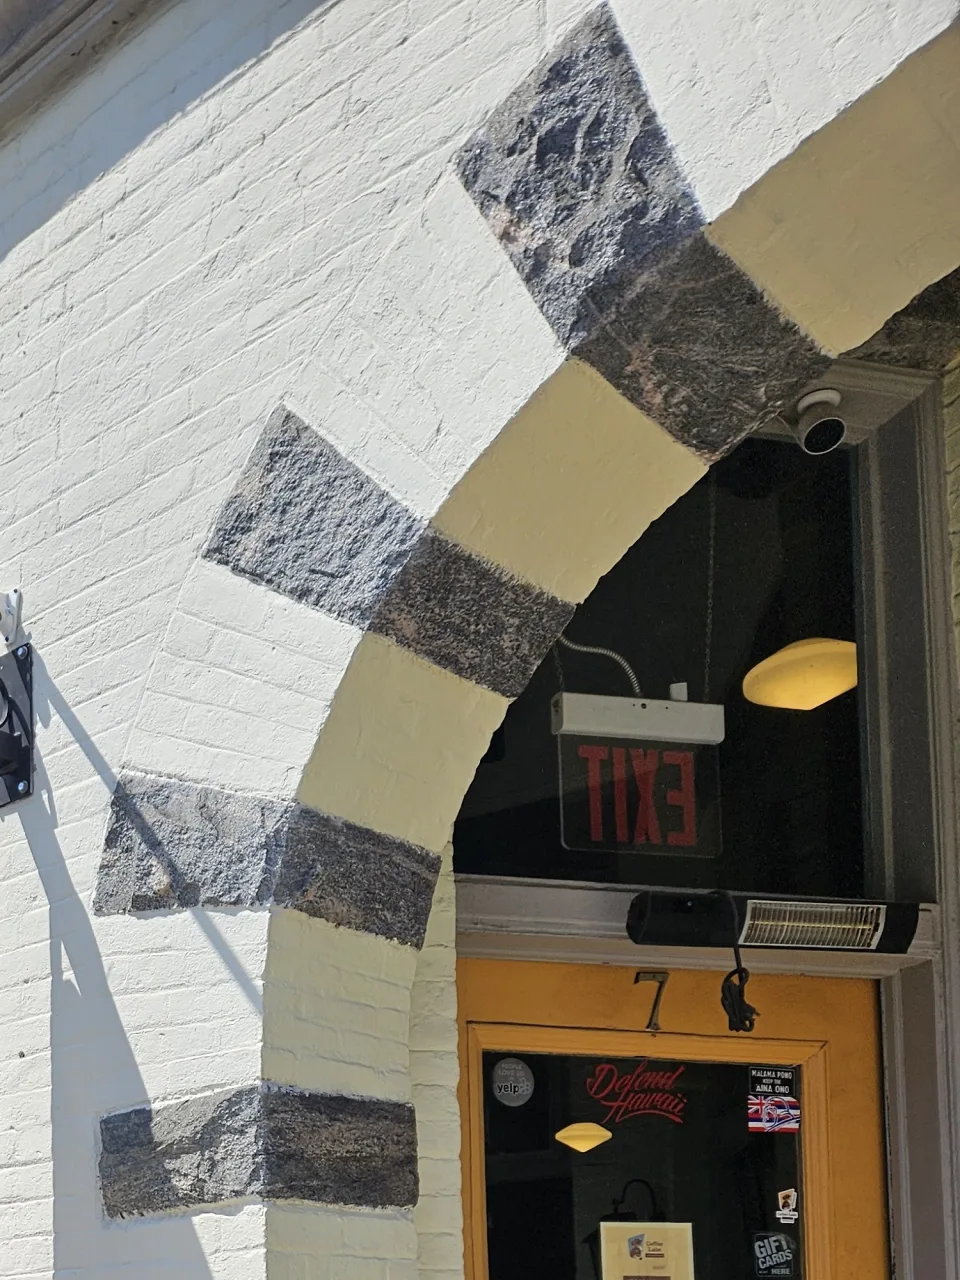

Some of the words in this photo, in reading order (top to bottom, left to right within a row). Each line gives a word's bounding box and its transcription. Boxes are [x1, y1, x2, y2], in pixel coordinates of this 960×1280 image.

[633, 971, 670, 1031] 7
[586, 1058, 686, 1100] Defend
[751, 1070, 776, 1078] MALAMA
[496, 1082, 520, 1095] yelp
[774, 1085, 790, 1094] ONO
[600, 1092, 688, 1124] Hawaii
[758, 1248, 794, 1270] CARDS
